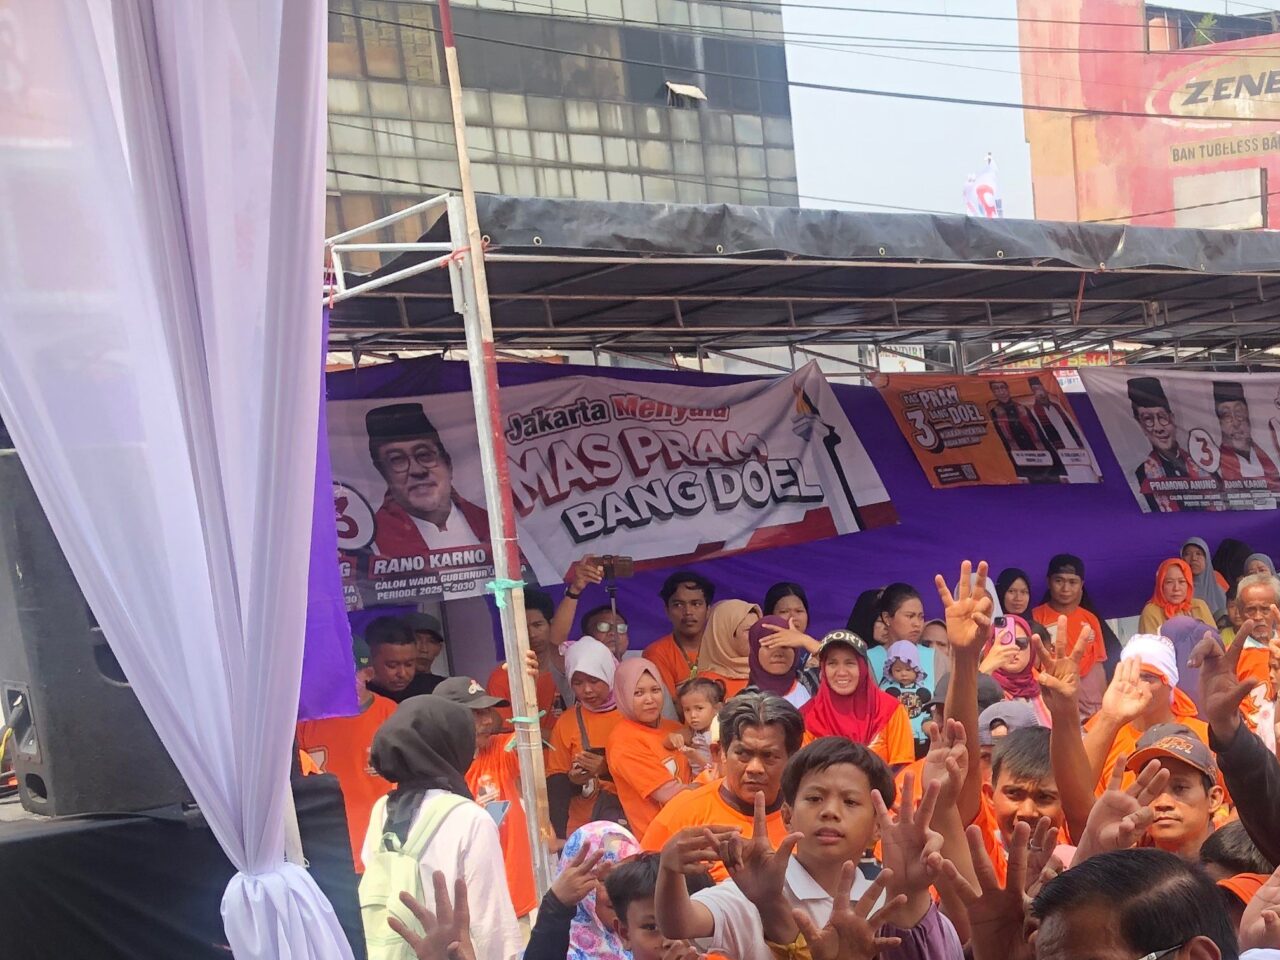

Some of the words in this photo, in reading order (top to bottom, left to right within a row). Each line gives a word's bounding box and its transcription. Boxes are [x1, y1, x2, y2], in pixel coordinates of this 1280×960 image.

[1172, 148, 1196, 162] BAN
[1199, 138, 1259, 158] TUBELESS
[505, 398, 610, 445] Jakarta
[906, 410, 936, 447] 3
[947, 404, 985, 425] DOEL
[1199, 438, 1215, 468] 3
[506, 433, 623, 518] MAS
[618, 426, 769, 478] PRAM
[561, 470, 707, 545] BANG
[706, 458, 825, 513] DOEL
[373, 556, 425, 575] RANO
[428, 549, 486, 569] KARNO
[374, 580, 408, 592] CALON
[408, 576, 438, 588] WAKIL
[439, 569, 488, 583] GUBERNUR
[376, 589, 418, 602] PERIODE
